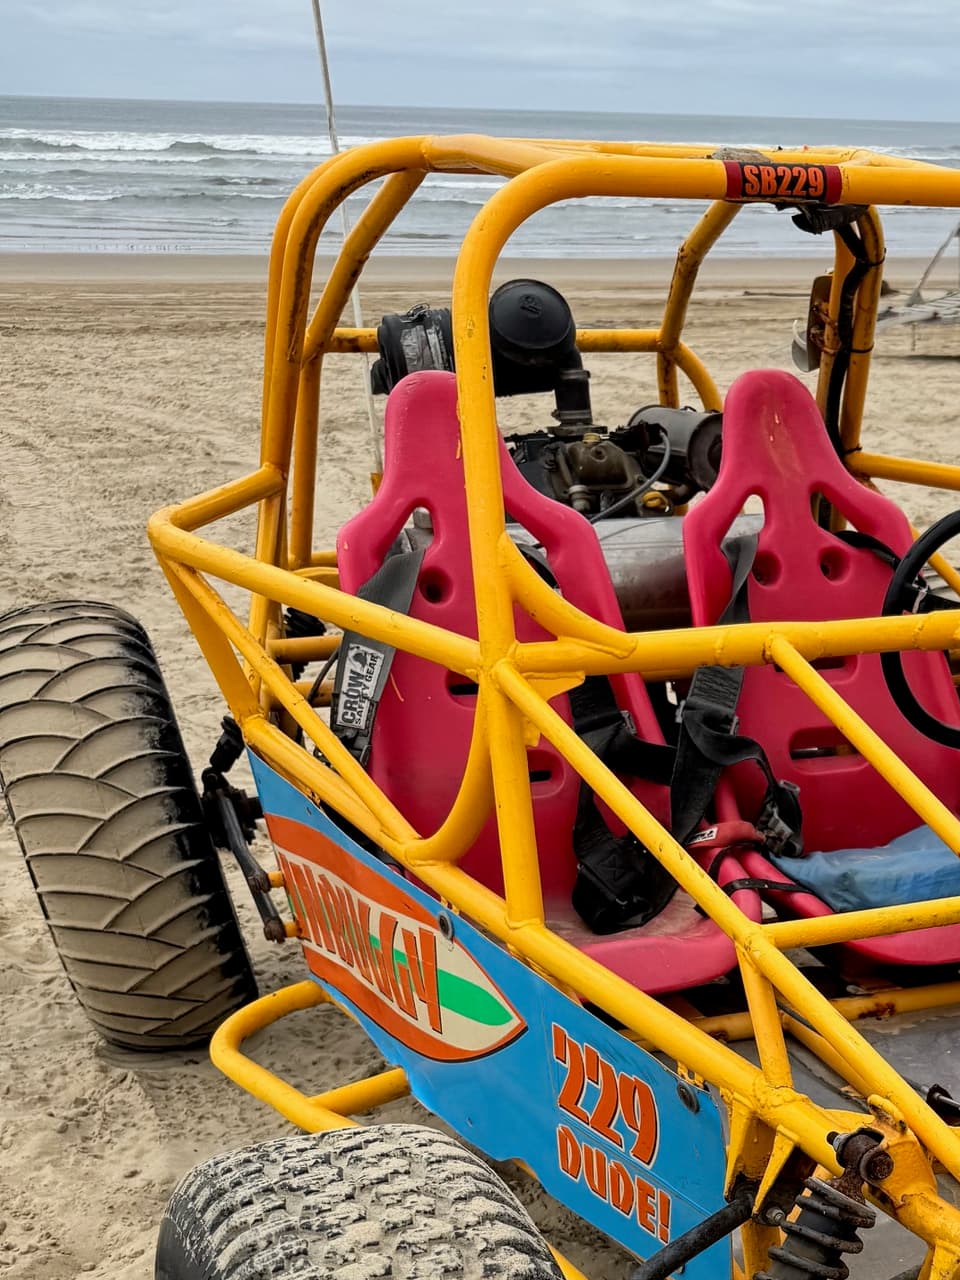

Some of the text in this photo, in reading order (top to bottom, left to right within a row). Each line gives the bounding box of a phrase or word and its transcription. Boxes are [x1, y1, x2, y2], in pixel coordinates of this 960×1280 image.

[743, 165, 825, 197] SB229
[341, 668, 365, 724] CROW
[355, 654, 379, 725] SAFETY GEAR
[552, 1022, 660, 1169] 229
[557, 1123, 672, 1246] DUDE!
